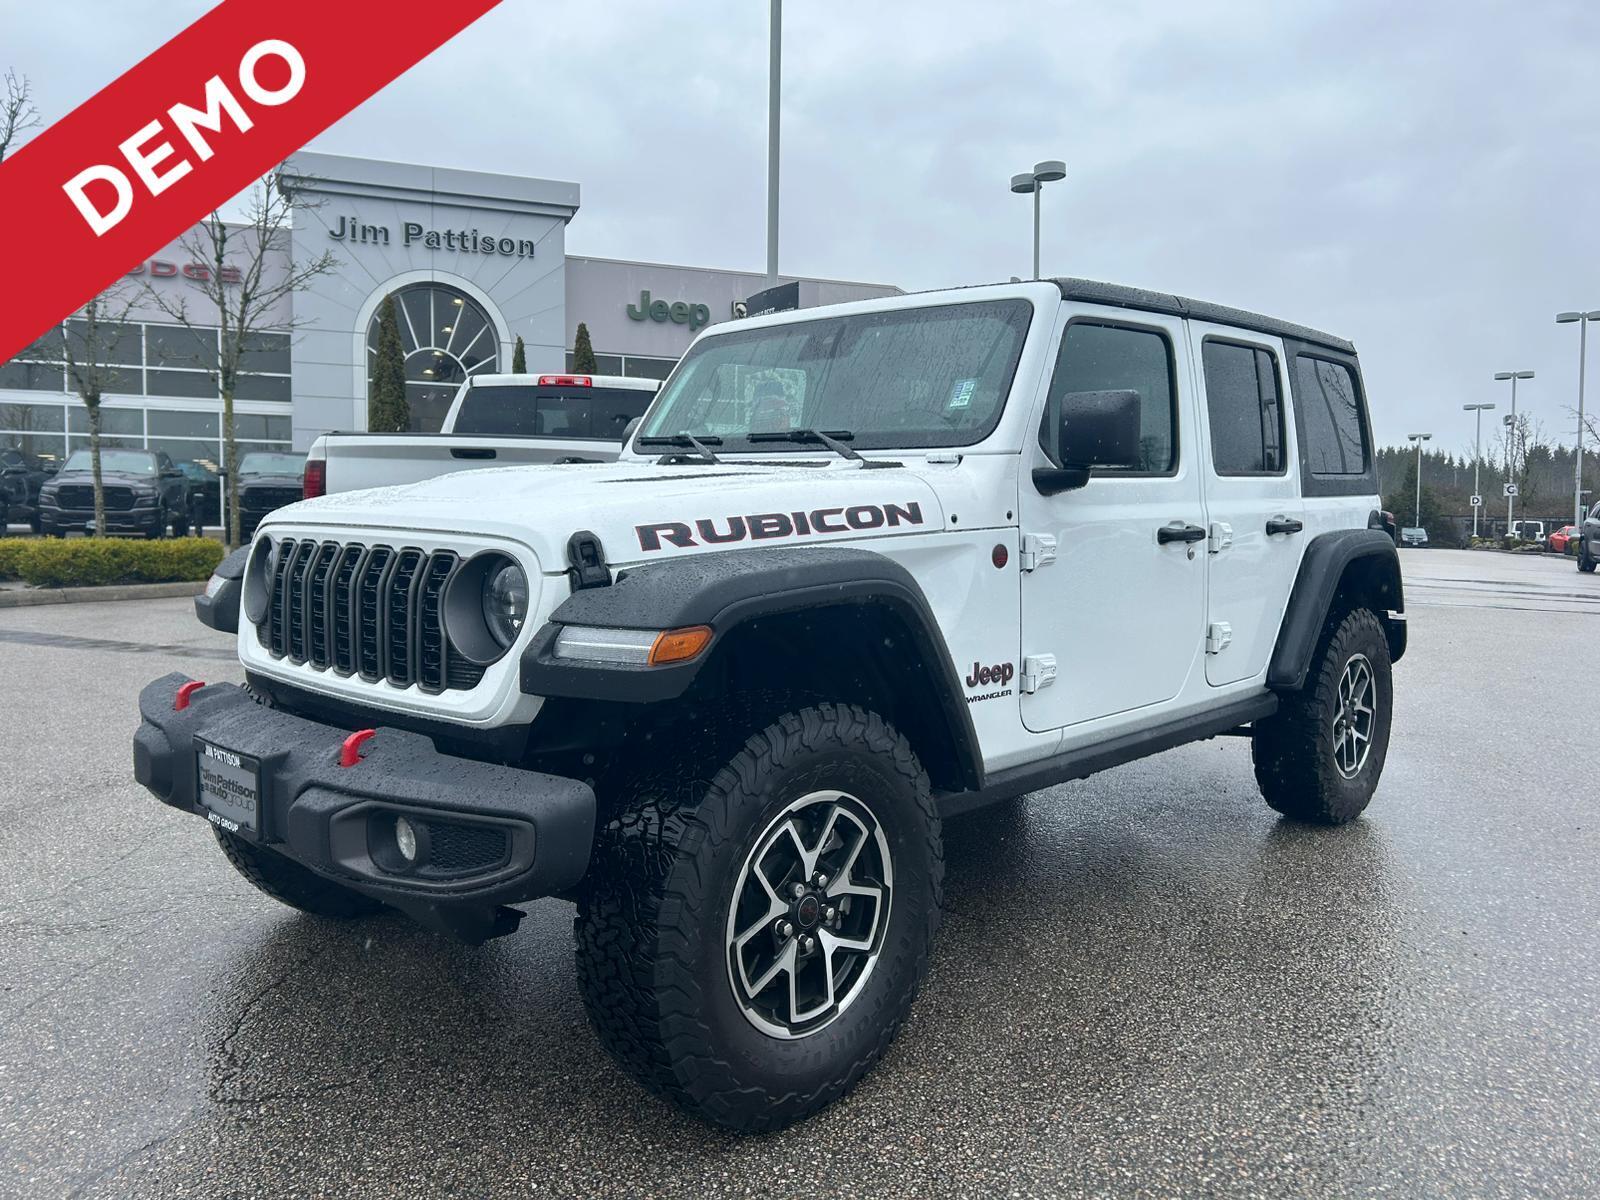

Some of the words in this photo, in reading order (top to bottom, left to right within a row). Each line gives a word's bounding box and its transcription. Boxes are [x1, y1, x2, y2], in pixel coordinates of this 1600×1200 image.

[328, 216, 390, 245] Jim
[403, 222, 536, 258] Pattison
[626, 290, 710, 331] Jeep
[635, 501, 924, 552] RUBICON
[966, 661, 1014, 688] Jeep
[965, 689, 1012, 703] WRANGLER
[213, 748, 240, 768] PATTISON
[208, 811, 220, 824] AUTO
[221, 818, 238, 832] GROUP
